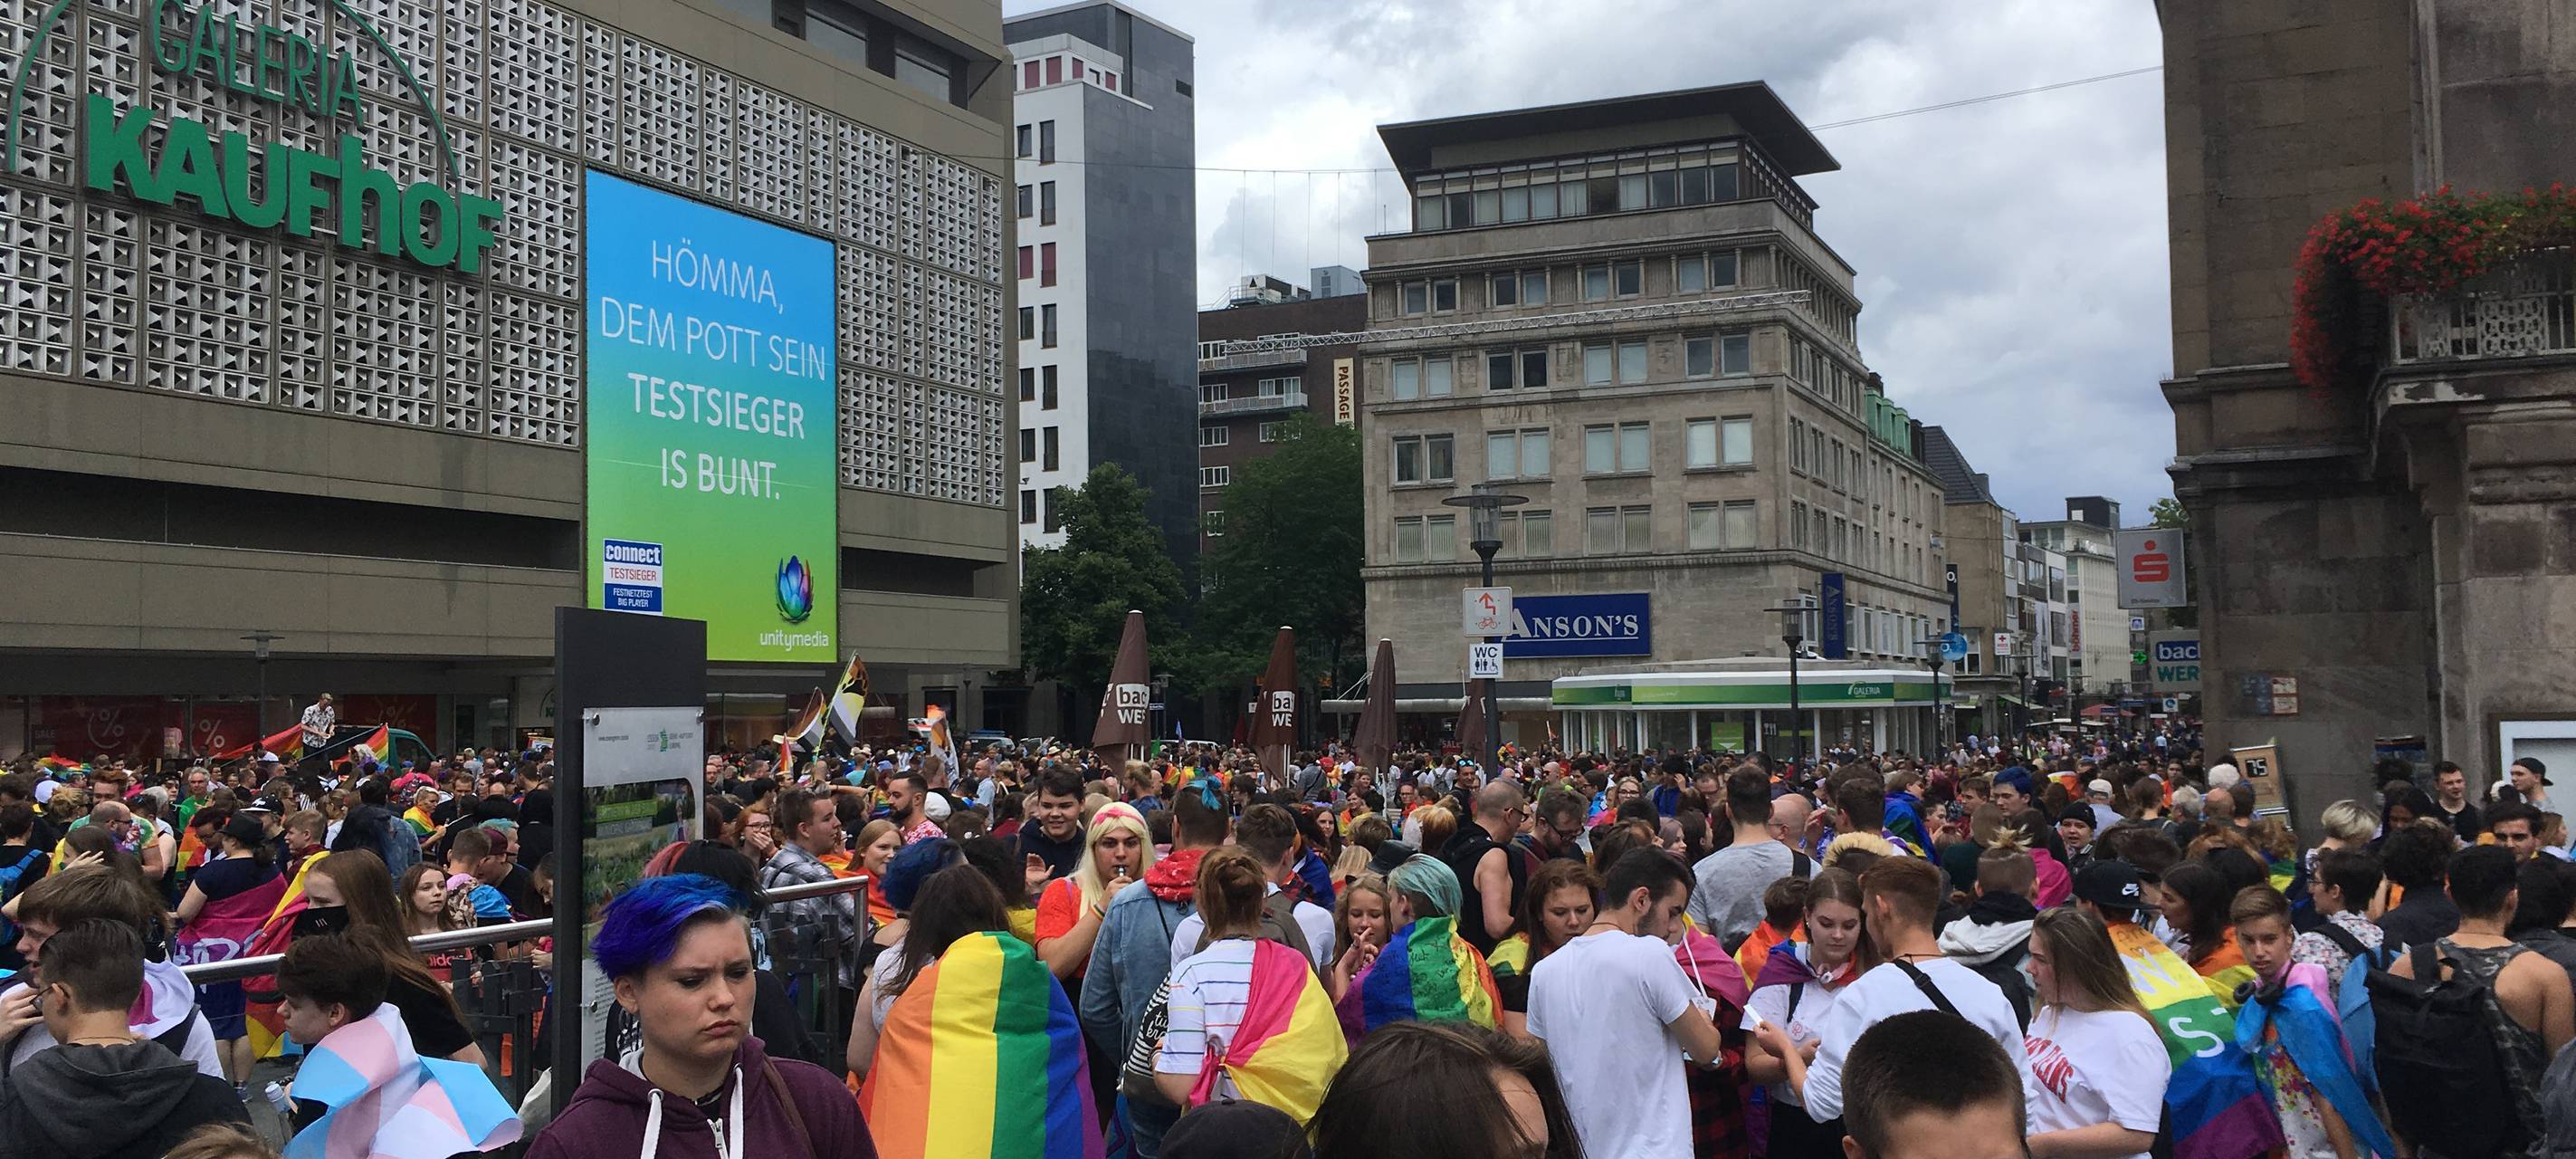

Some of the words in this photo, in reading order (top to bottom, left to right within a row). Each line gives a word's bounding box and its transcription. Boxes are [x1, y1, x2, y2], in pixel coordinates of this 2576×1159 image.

[151, 0, 364, 129] GALERIA
[652, 236, 784, 315] HÖMMA,
[601, 295, 676, 351] DEM
[687, 316, 761, 367] POTT
[769, 335, 825, 381] SEIN
[627, 372, 805, 439] TESTSIEGER
[1338, 366, 1350, 420] PASSAGE
[662, 447, 688, 489] IS
[698, 453, 780, 500] BUNT.
[606, 544, 661, 564] connect
[609, 567, 657, 581] TESTSIEGER
[617, 597, 627, 606] BIG
[628, 599, 649, 608] PLAYER
[1503, 608, 1639, 638] ANSON'S
[759, 629, 829, 652] unitymedia
[1474, 647, 1498, 658] WC
[2158, 643, 2200, 659] bac
[1853, 686, 1881, 695] GALERIA
